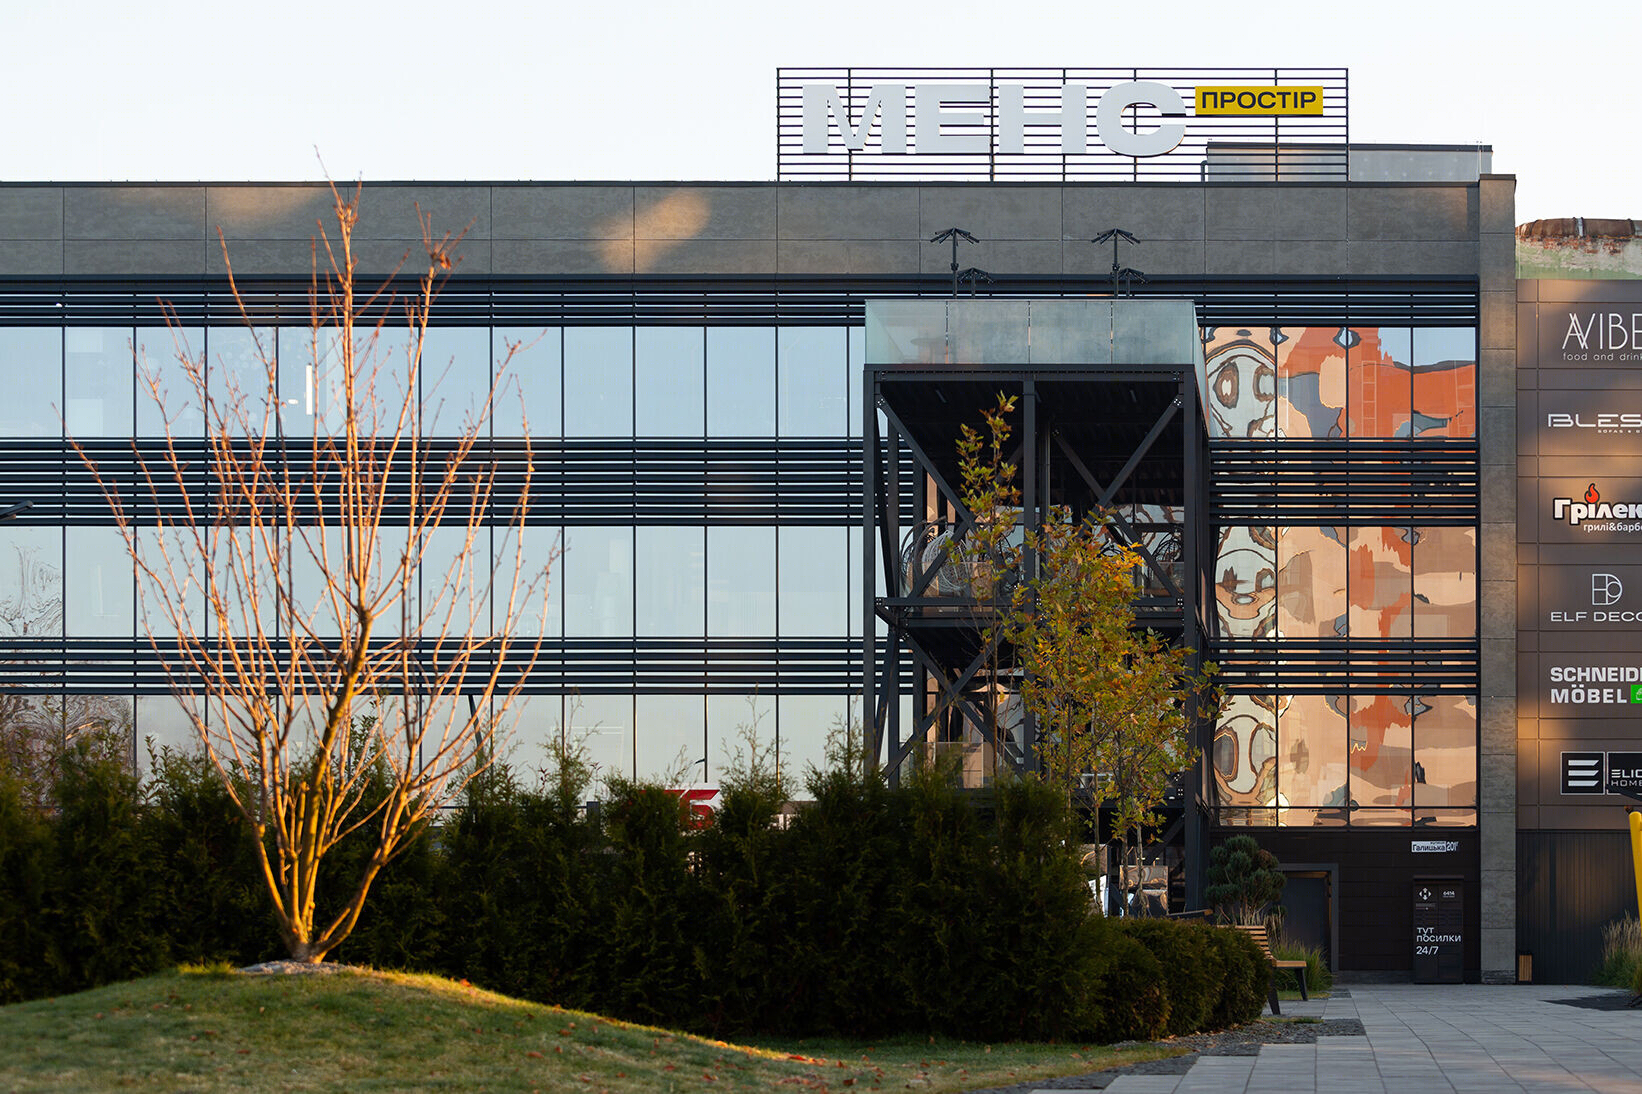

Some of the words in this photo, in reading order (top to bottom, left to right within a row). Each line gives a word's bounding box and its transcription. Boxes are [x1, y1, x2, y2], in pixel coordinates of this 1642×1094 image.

[1202, 91, 1316, 109] ПРОСТІР
[802, 82, 1187, 157] МЕНС
[1563, 353, 1588, 361] food
[1593, 353, 1614, 361] and
[1583, 522, 1642, 533] грилі&барб
[1550, 612, 1588, 622] ELF
[1550, 667, 1642, 682] SCHNEID
[1550, 684, 1627, 704] MÖBEL
[1416, 945, 1439, 955] 24/7
